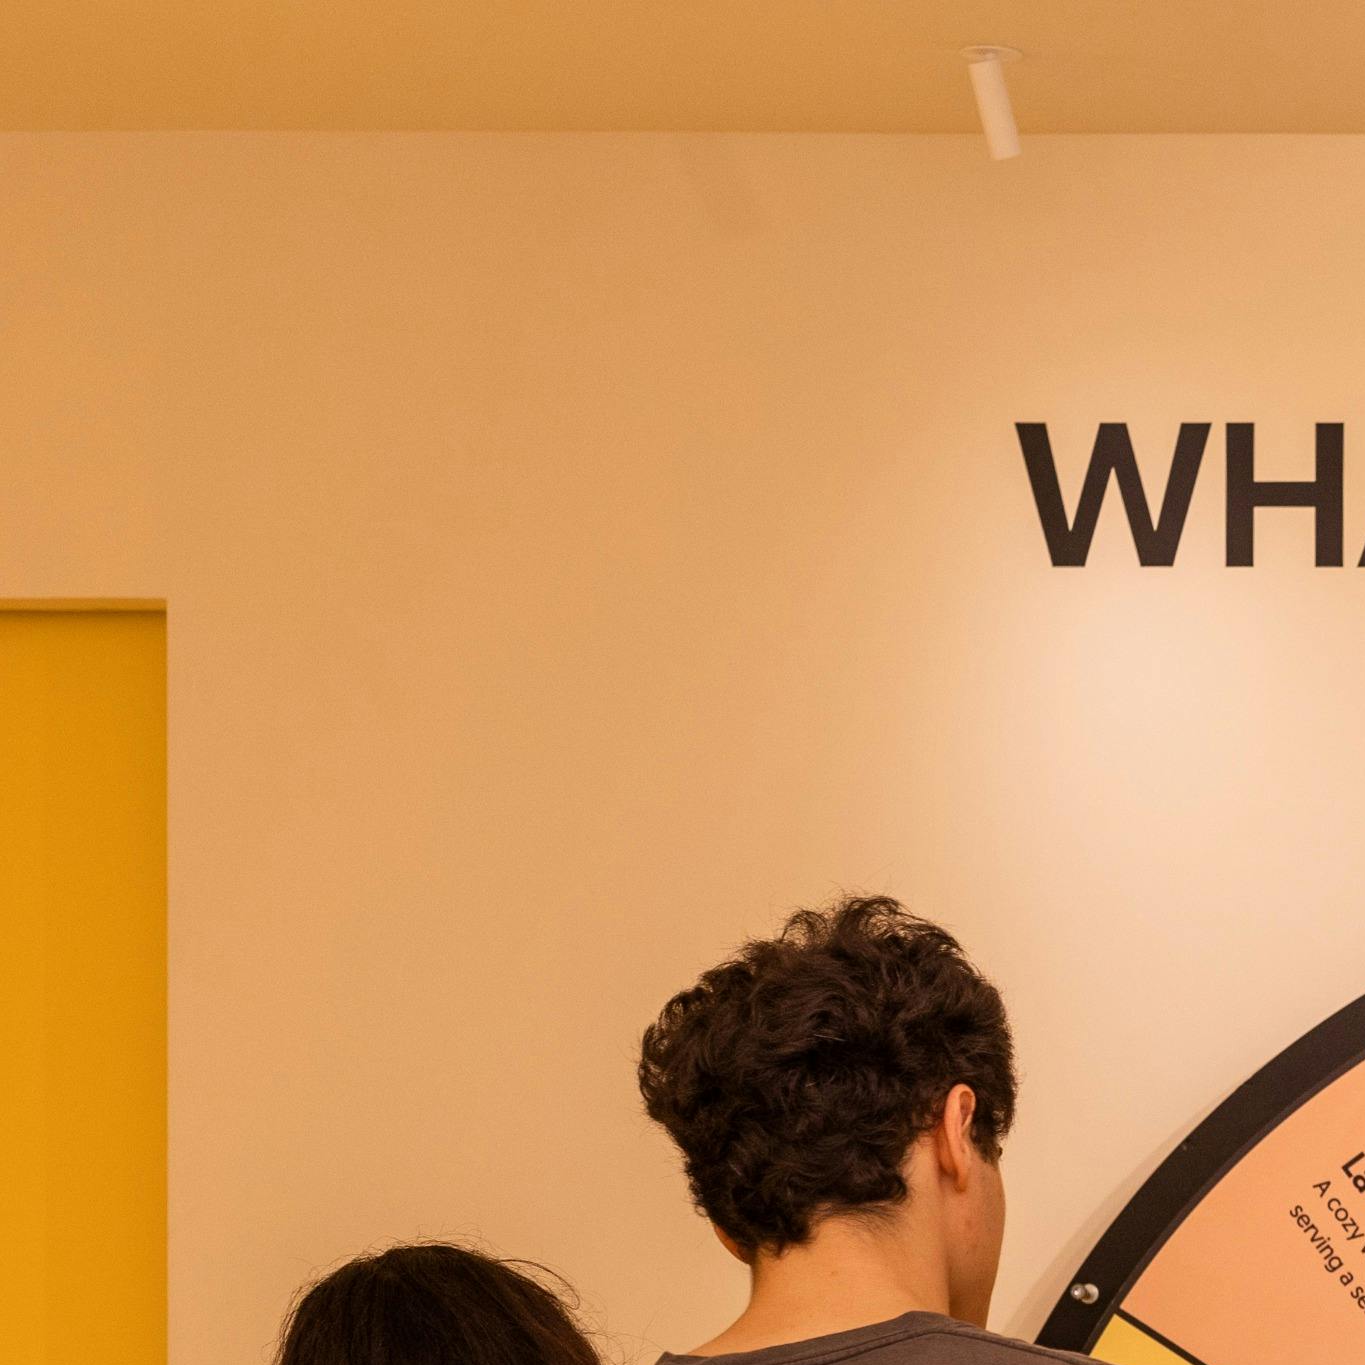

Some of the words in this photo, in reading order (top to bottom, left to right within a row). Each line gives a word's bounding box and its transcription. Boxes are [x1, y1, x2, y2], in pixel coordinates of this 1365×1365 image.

[1289, 1204, 1344, 1274] serving
[1339, 1271, 1354, 1287] a
[1312, 1180, 1332, 1198] A
[1326, 1197, 1365, 1241] cozy
